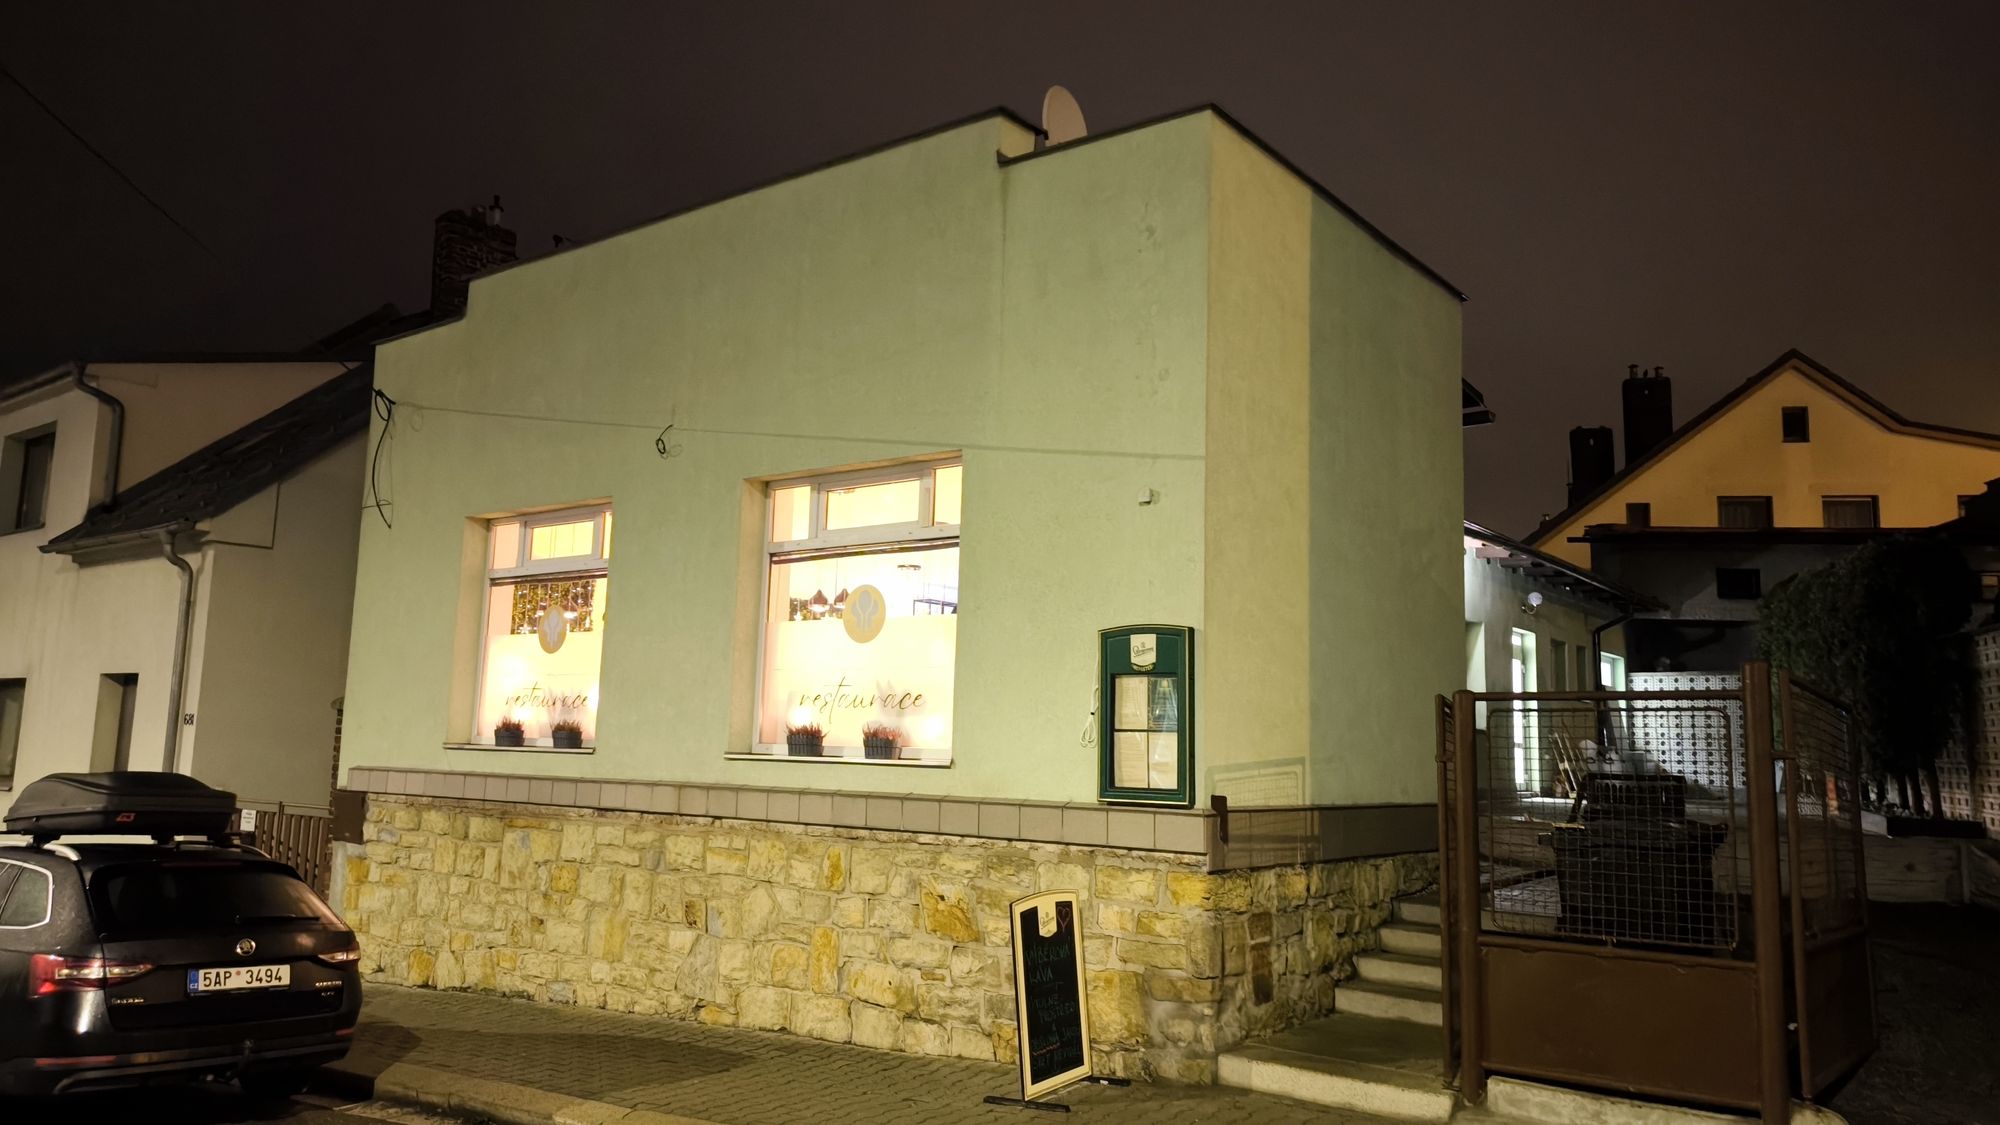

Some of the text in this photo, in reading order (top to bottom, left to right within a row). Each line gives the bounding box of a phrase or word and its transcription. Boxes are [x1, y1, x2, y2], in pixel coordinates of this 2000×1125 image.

[505, 682, 589, 709] restaurace
[800, 676, 926, 724] restaurace
[203, 970, 232, 988] 5AP
[245, 967, 283, 985] 3494
